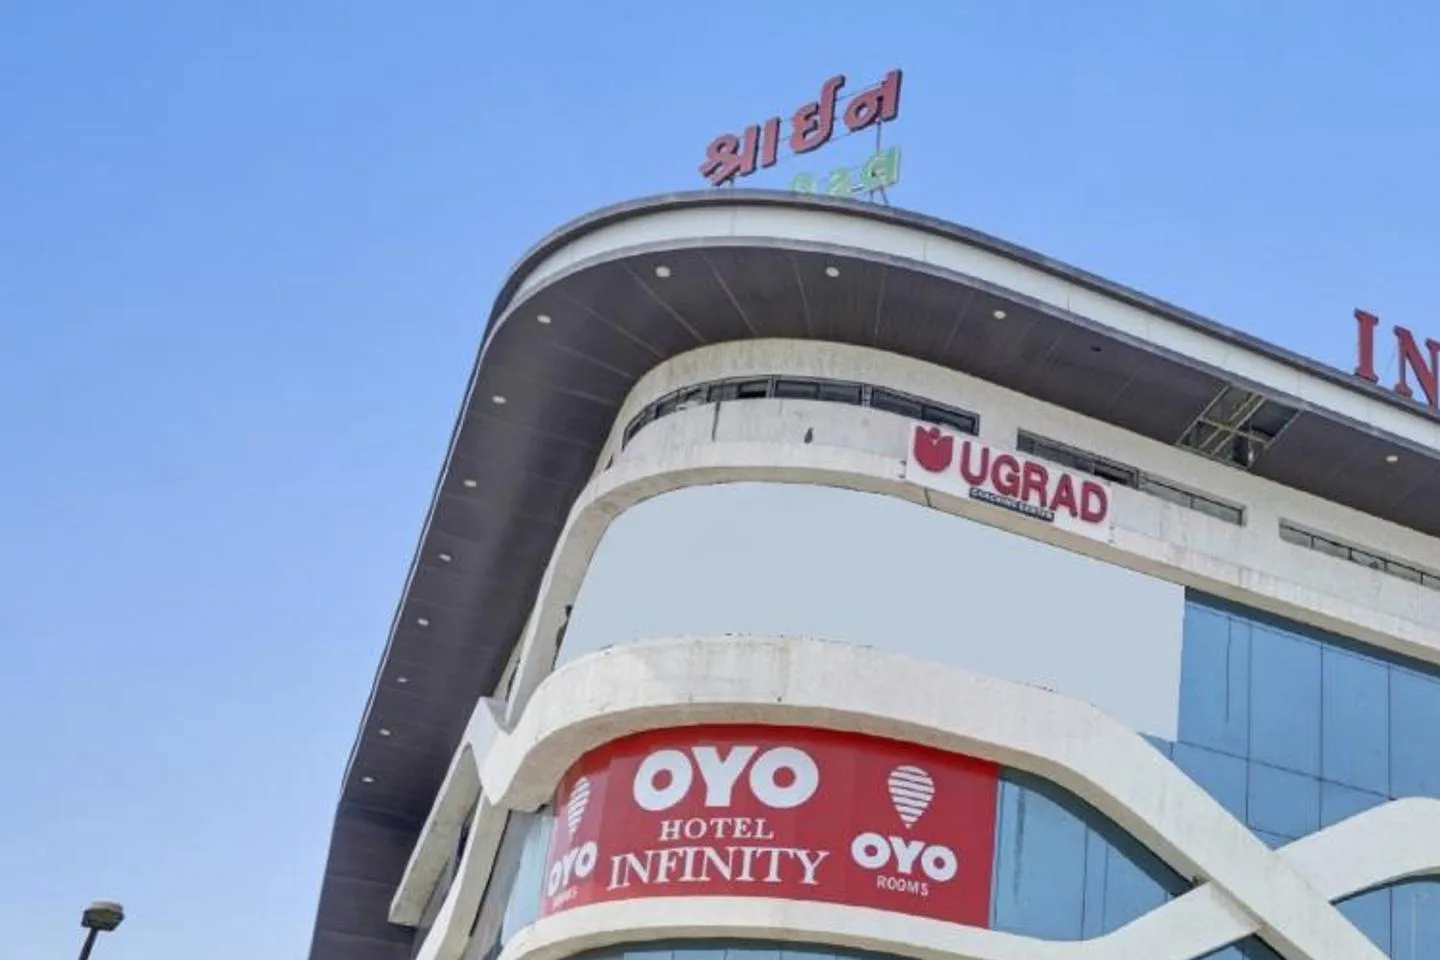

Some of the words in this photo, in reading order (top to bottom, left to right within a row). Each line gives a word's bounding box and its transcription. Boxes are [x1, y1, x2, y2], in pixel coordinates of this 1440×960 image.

[960, 440, 1109, 524] UGRAD
[633, 746, 819, 811] OYO
[659, 817, 774, 841] HOTEL
[547, 841, 597, 896] OYO
[606, 846, 829, 891] INFINITY
[851, 832, 957, 881] OYO
[876, 874, 928, 897] ROOMS
